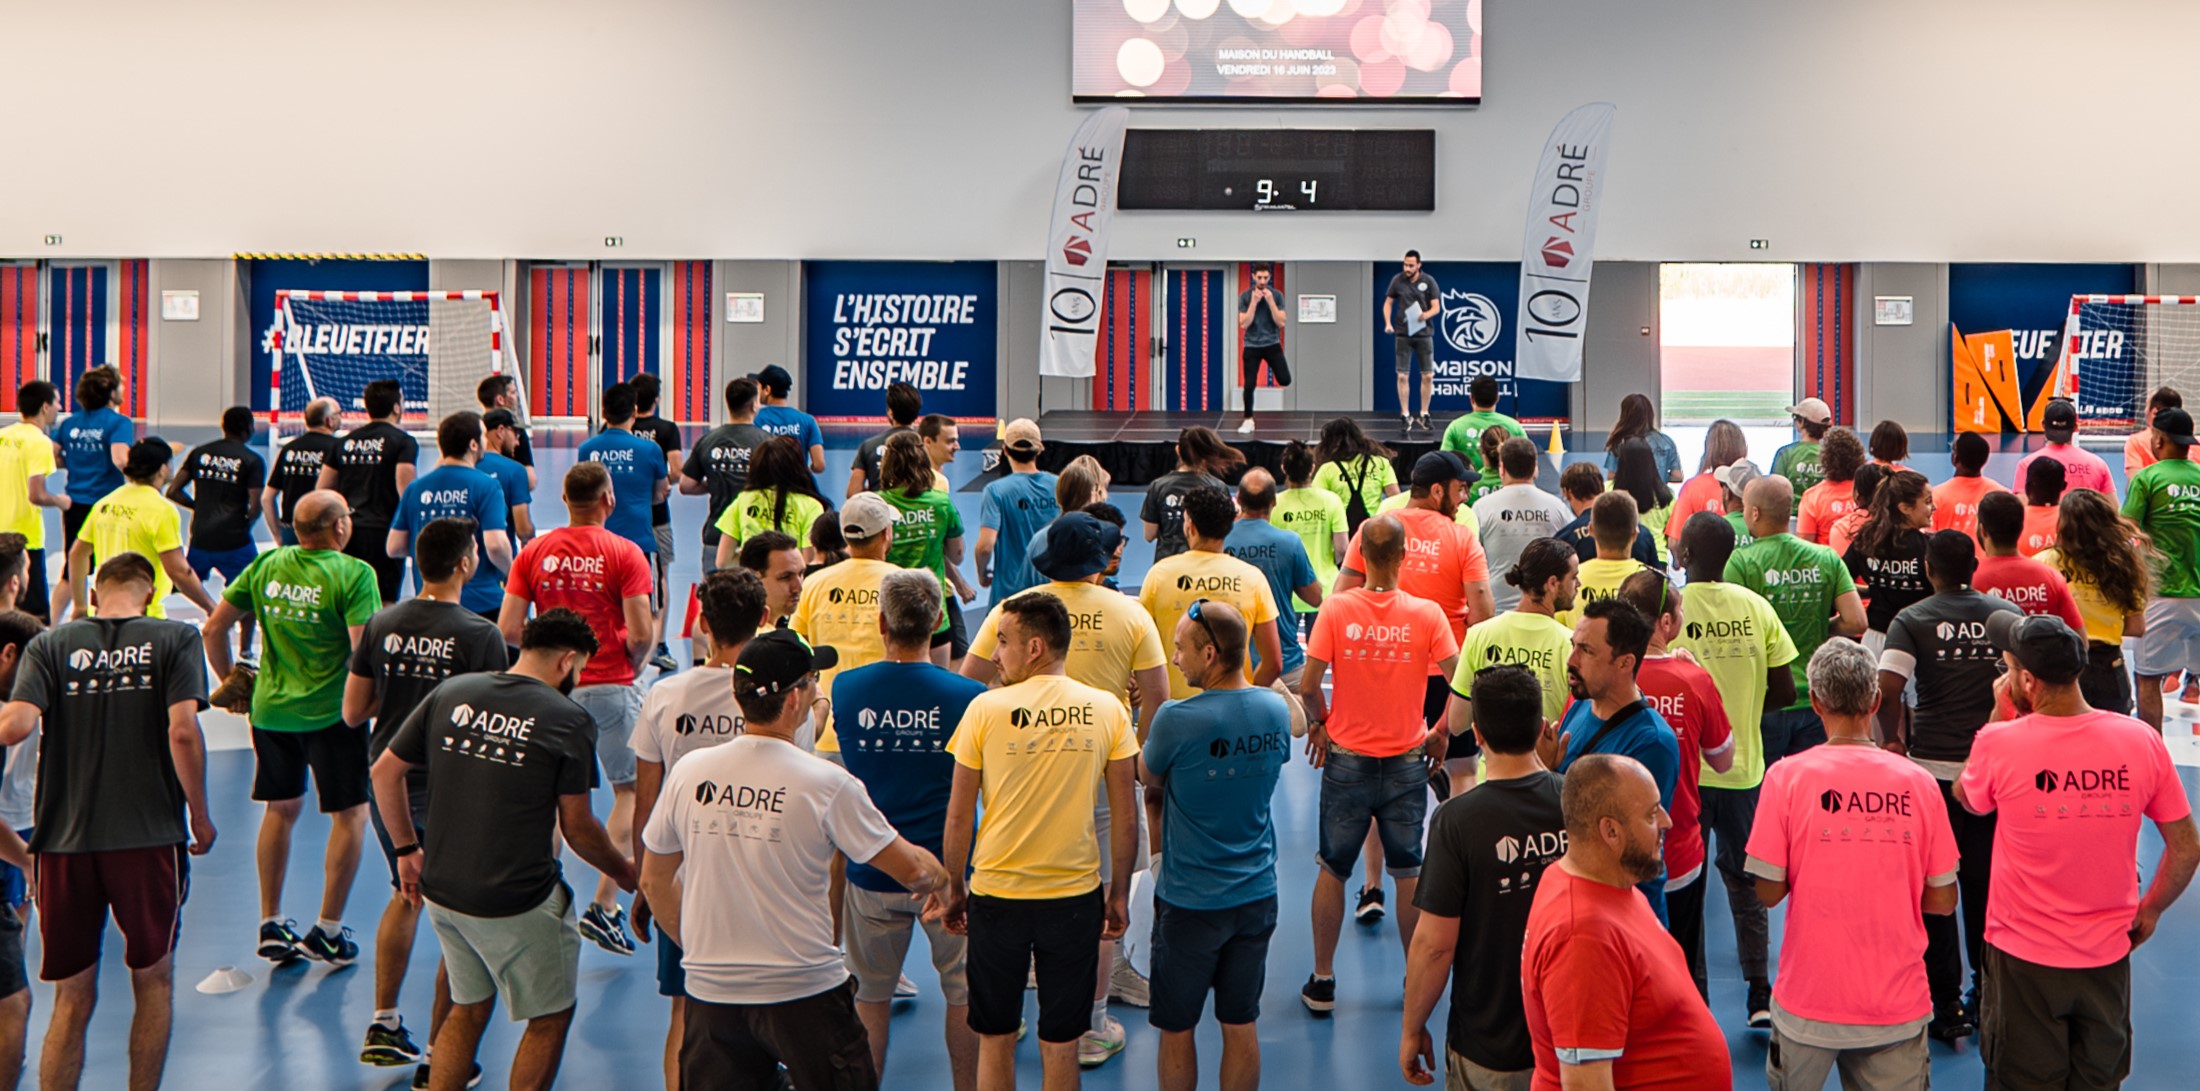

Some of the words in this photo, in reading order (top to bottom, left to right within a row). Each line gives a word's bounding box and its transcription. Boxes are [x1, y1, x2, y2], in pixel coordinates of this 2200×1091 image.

[1219, 49, 1260, 60] MAISON
[1262, 49, 1278, 60] DU
[1280, 49, 1335, 60] HANDBALL
[1216, 63, 1271, 75] VENDREDI
[1287, 64, 1311, 75] JUIN
[1312, 64, 1337, 75] 2023
[1070, 146, 1105, 232] ADRÉ
[1300, 179, 1318, 203] 4
[1549, 143, 1589, 233] ADRÉ
[1582, 169, 1596, 212] GROUPE
[833, 294, 977, 324] L'HISTOIRE
[833, 317, 936, 357] S'ÉCRIT
[833, 360, 969, 390] ENSEMBLE
[633, 428, 657, 441] DRÉ
[772, 422, 801, 436] ADRÉ
[355, 437, 385, 452] ADRÉ
[600, 448, 634, 461] ADRÉ
[722, 447, 752, 461] ADRÉ
[211, 456, 242, 472] ADRÉ
[294, 450, 324, 464] ADRÉ
[1806, 463, 1824, 474] AD
[434, 488, 469, 505] ADRÉ
[2181, 485, 2200, 498] AD
[1296, 509, 1326, 522] ADRÉ
[1515, 509, 1550, 522] ADRÉ
[1237, 543, 1276, 559] ADRÉ
[560, 554, 605, 574] ADRÉ
[1880, 558, 1918, 575] ADRÉ
[1195, 575, 1241, 592] ADRÉ
[1781, 565, 1822, 585] ADRÉ
[281, 584, 322, 605] ADRÉ
[846, 589, 880, 605] ADR
[2005, 584, 2048, 602] ADRÉ
[1068, 611, 1103, 630] DRÉ
[1705, 616, 1753, 638] ADRÉ
[1364, 624, 1411, 643] ADRÉ
[1957, 622, 1987, 640] AD
[95, 642, 152, 669] ADRÉ
[403, 636, 456, 659] ADRÉ
[1505, 648, 1553, 669] ADRÉ
[1648, 693, 1685, 716] DRÉ
[700, 714, 746, 736] ADR
[880, 706, 940, 729] ADRÉ
[1035, 702, 1094, 728] ADRÉ
[472, 710, 536, 741] ADRÉ
[1233, 727, 1281, 756] ADRÉ
[2063, 765, 2130, 792] ADRÉ
[719, 785, 787, 814] ADRÉ
[1847, 791, 1911, 817] ADRÉ
[1524, 830, 1568, 859] ADR
